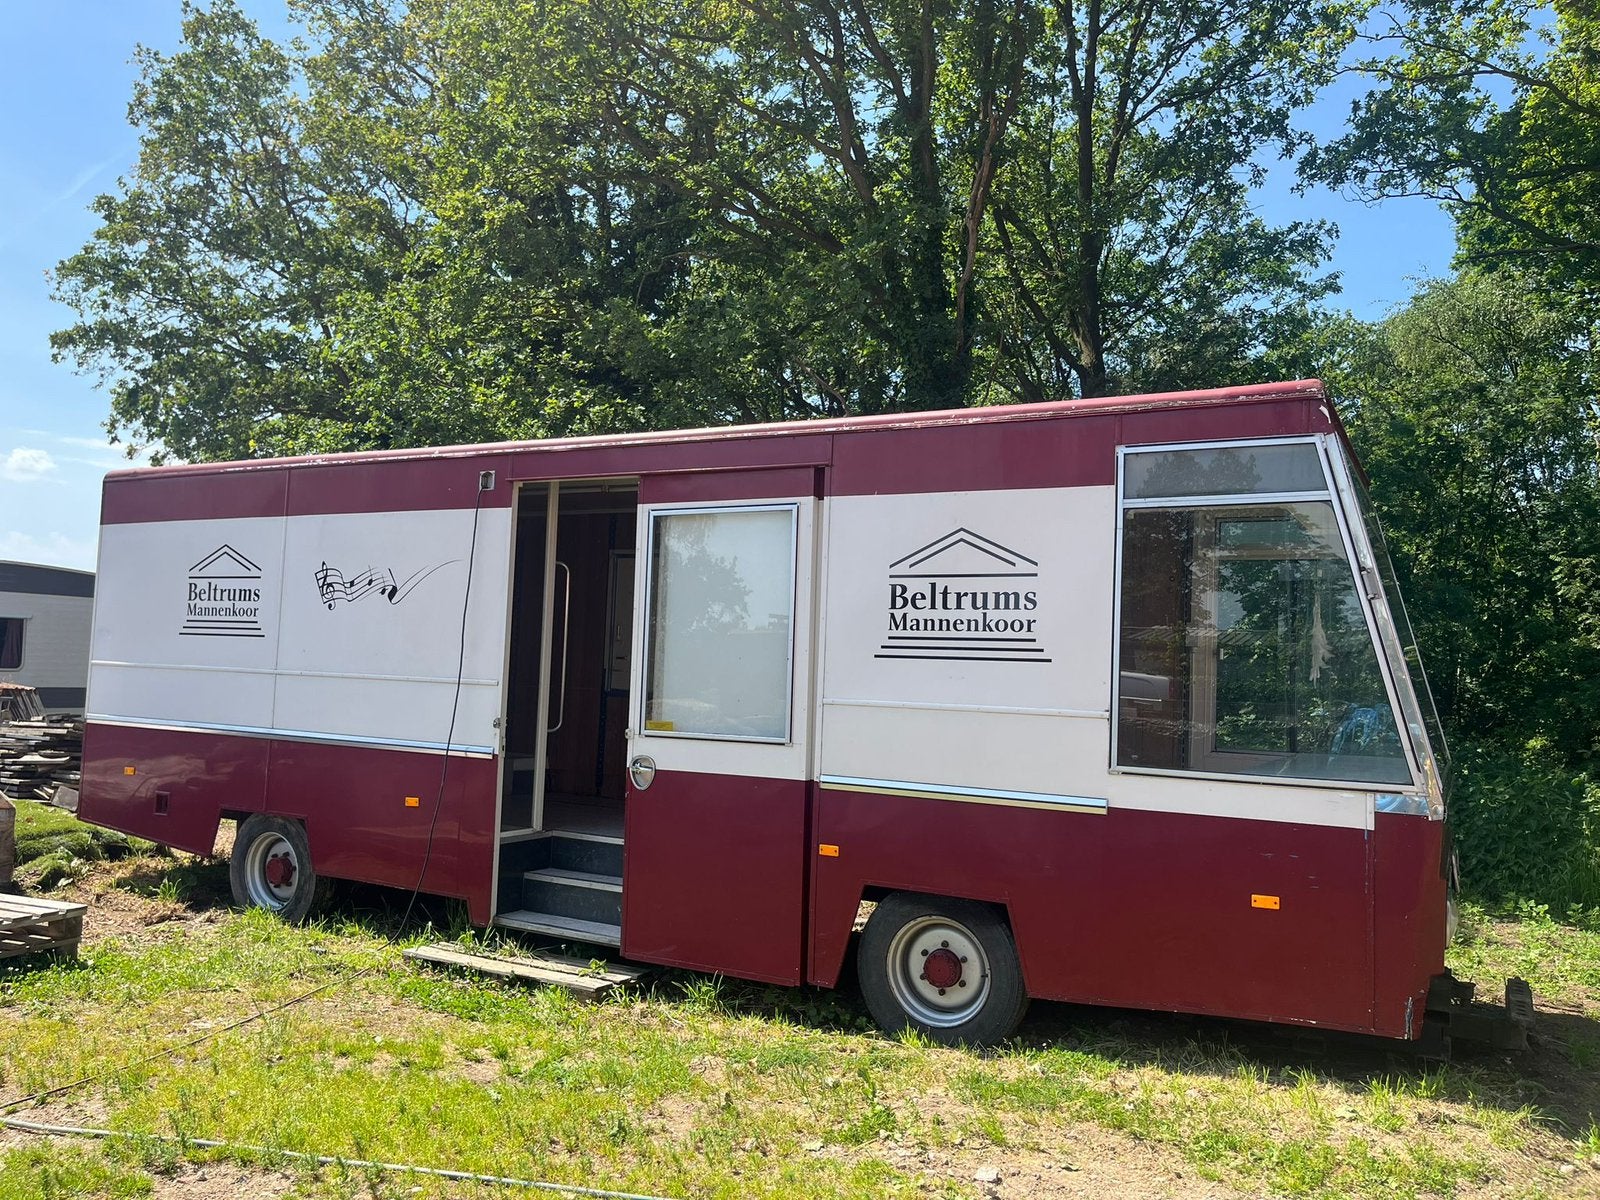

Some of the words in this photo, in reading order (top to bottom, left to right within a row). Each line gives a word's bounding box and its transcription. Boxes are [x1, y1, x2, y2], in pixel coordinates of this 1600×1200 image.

[188, 582, 260, 602] Beltrums
[888, 582, 1038, 611] Beltrums
[187, 603, 259, 617] Mannenkoor
[888, 612, 1036, 633] Mannenkoor
